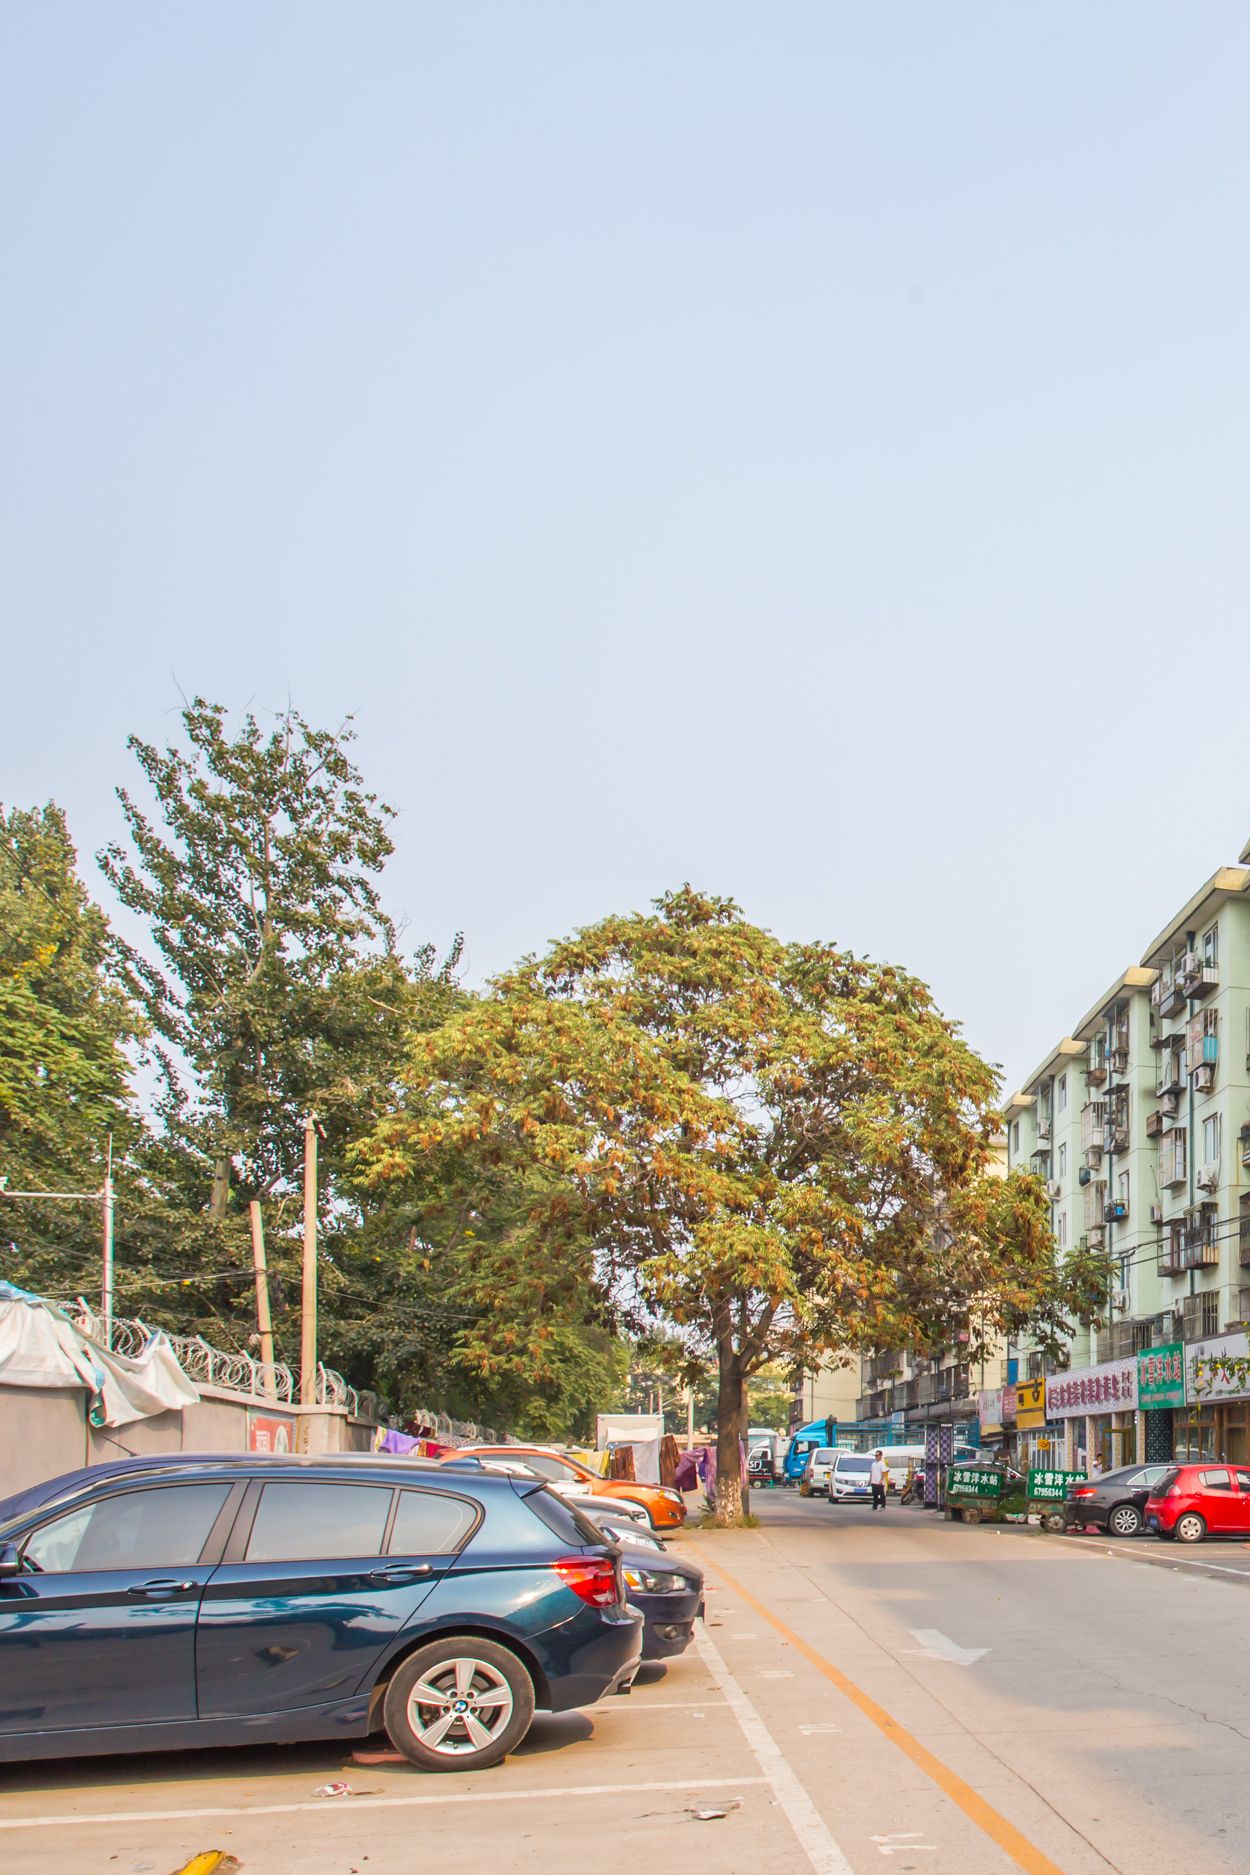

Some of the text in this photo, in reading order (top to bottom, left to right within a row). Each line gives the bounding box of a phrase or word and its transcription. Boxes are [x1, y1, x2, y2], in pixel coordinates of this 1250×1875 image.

[952, 1471, 998, 1486] 冰雪洋水站
